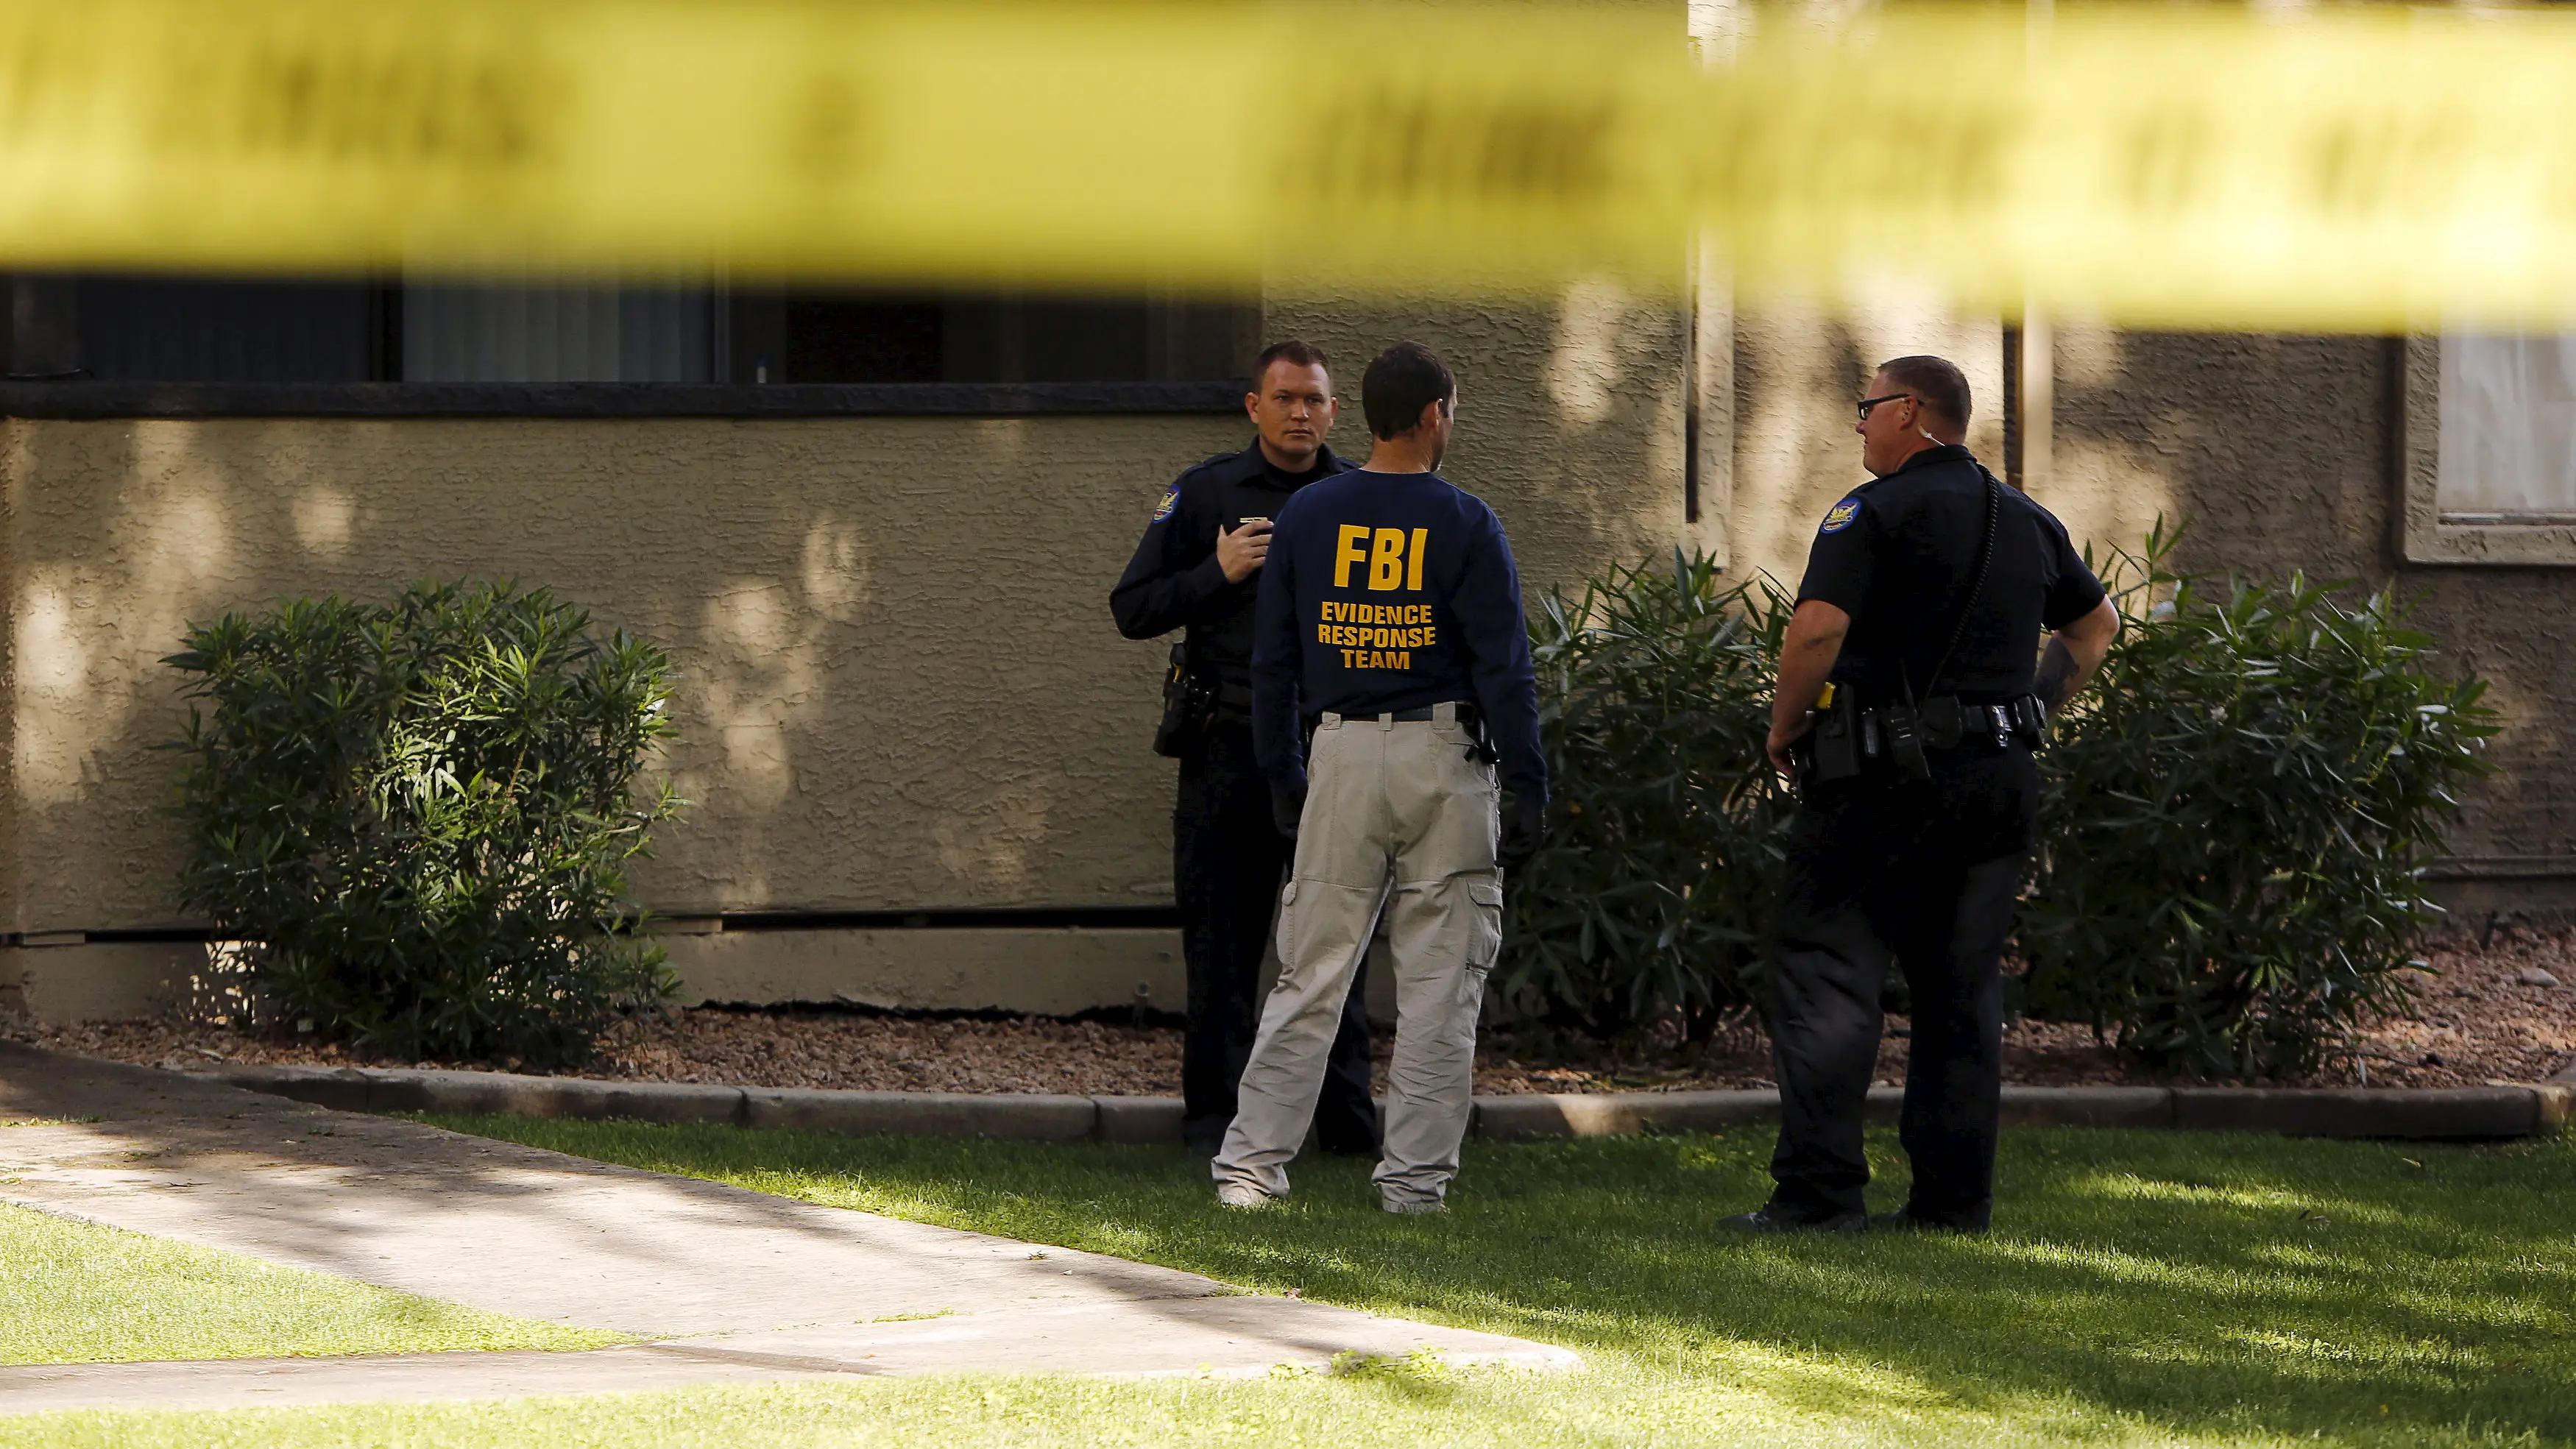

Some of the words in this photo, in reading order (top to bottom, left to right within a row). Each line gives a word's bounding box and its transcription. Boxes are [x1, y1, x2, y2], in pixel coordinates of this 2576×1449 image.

[1334, 524, 1428, 590] FBI
[1321, 601, 1432, 624] EVIDENCE
[1318, 624, 1436, 648] RESPONSE
[1340, 649, 1410, 669] TEAM
